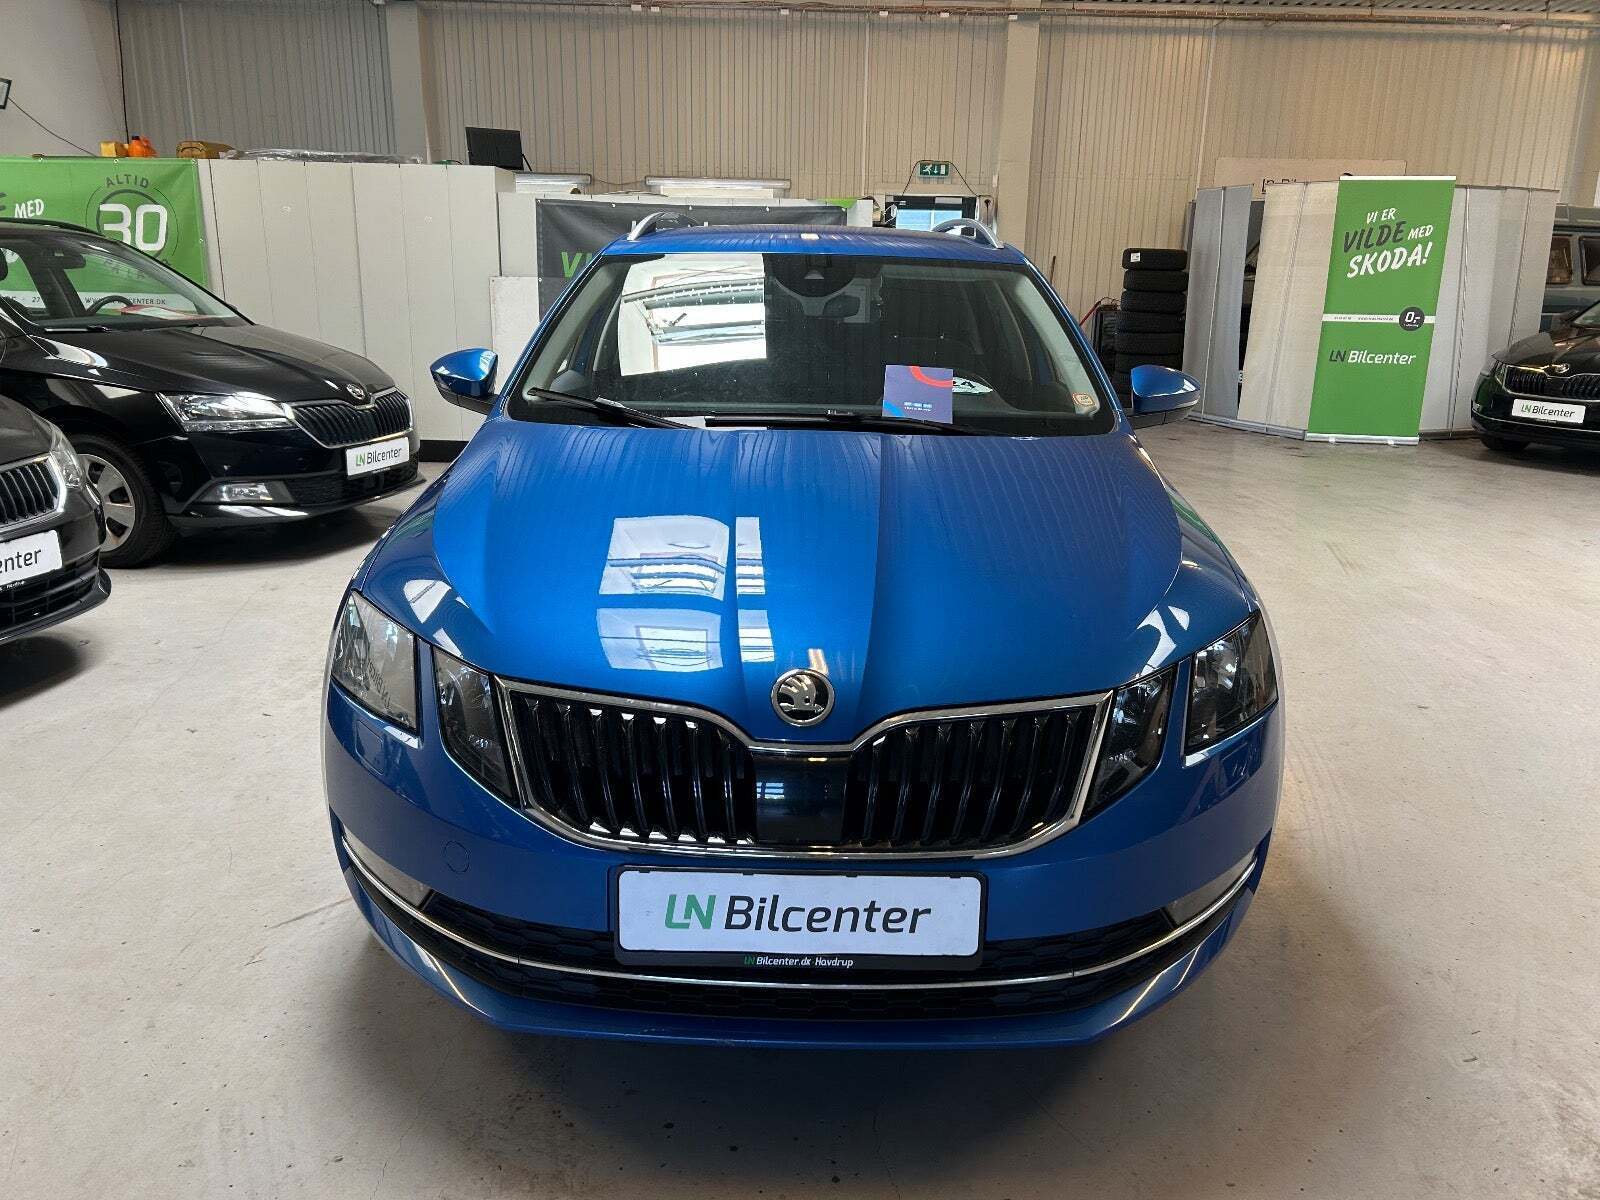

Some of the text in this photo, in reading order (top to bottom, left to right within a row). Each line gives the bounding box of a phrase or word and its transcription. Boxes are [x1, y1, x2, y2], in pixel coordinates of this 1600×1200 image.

[106, 174, 149, 188] ALTID
[14, 199, 44, 218] MED
[1366, 208, 1396, 223] VI ER
[100, 204, 168, 251] 30
[1344, 221, 1433, 252] VILDE MED
[1347, 242, 1432, 278] SKODA!
[1329, 350, 1416, 364] LN Bilcenter
[1521, 404, 1575, 418] LN Bilcenter
[356, 448, 402, 467] LN Bilcenter
[0, 549, 41, 573] nter
[664, 894, 931, 933] LN Bilcenter
[815, 957, 854, 969] Havdrup
